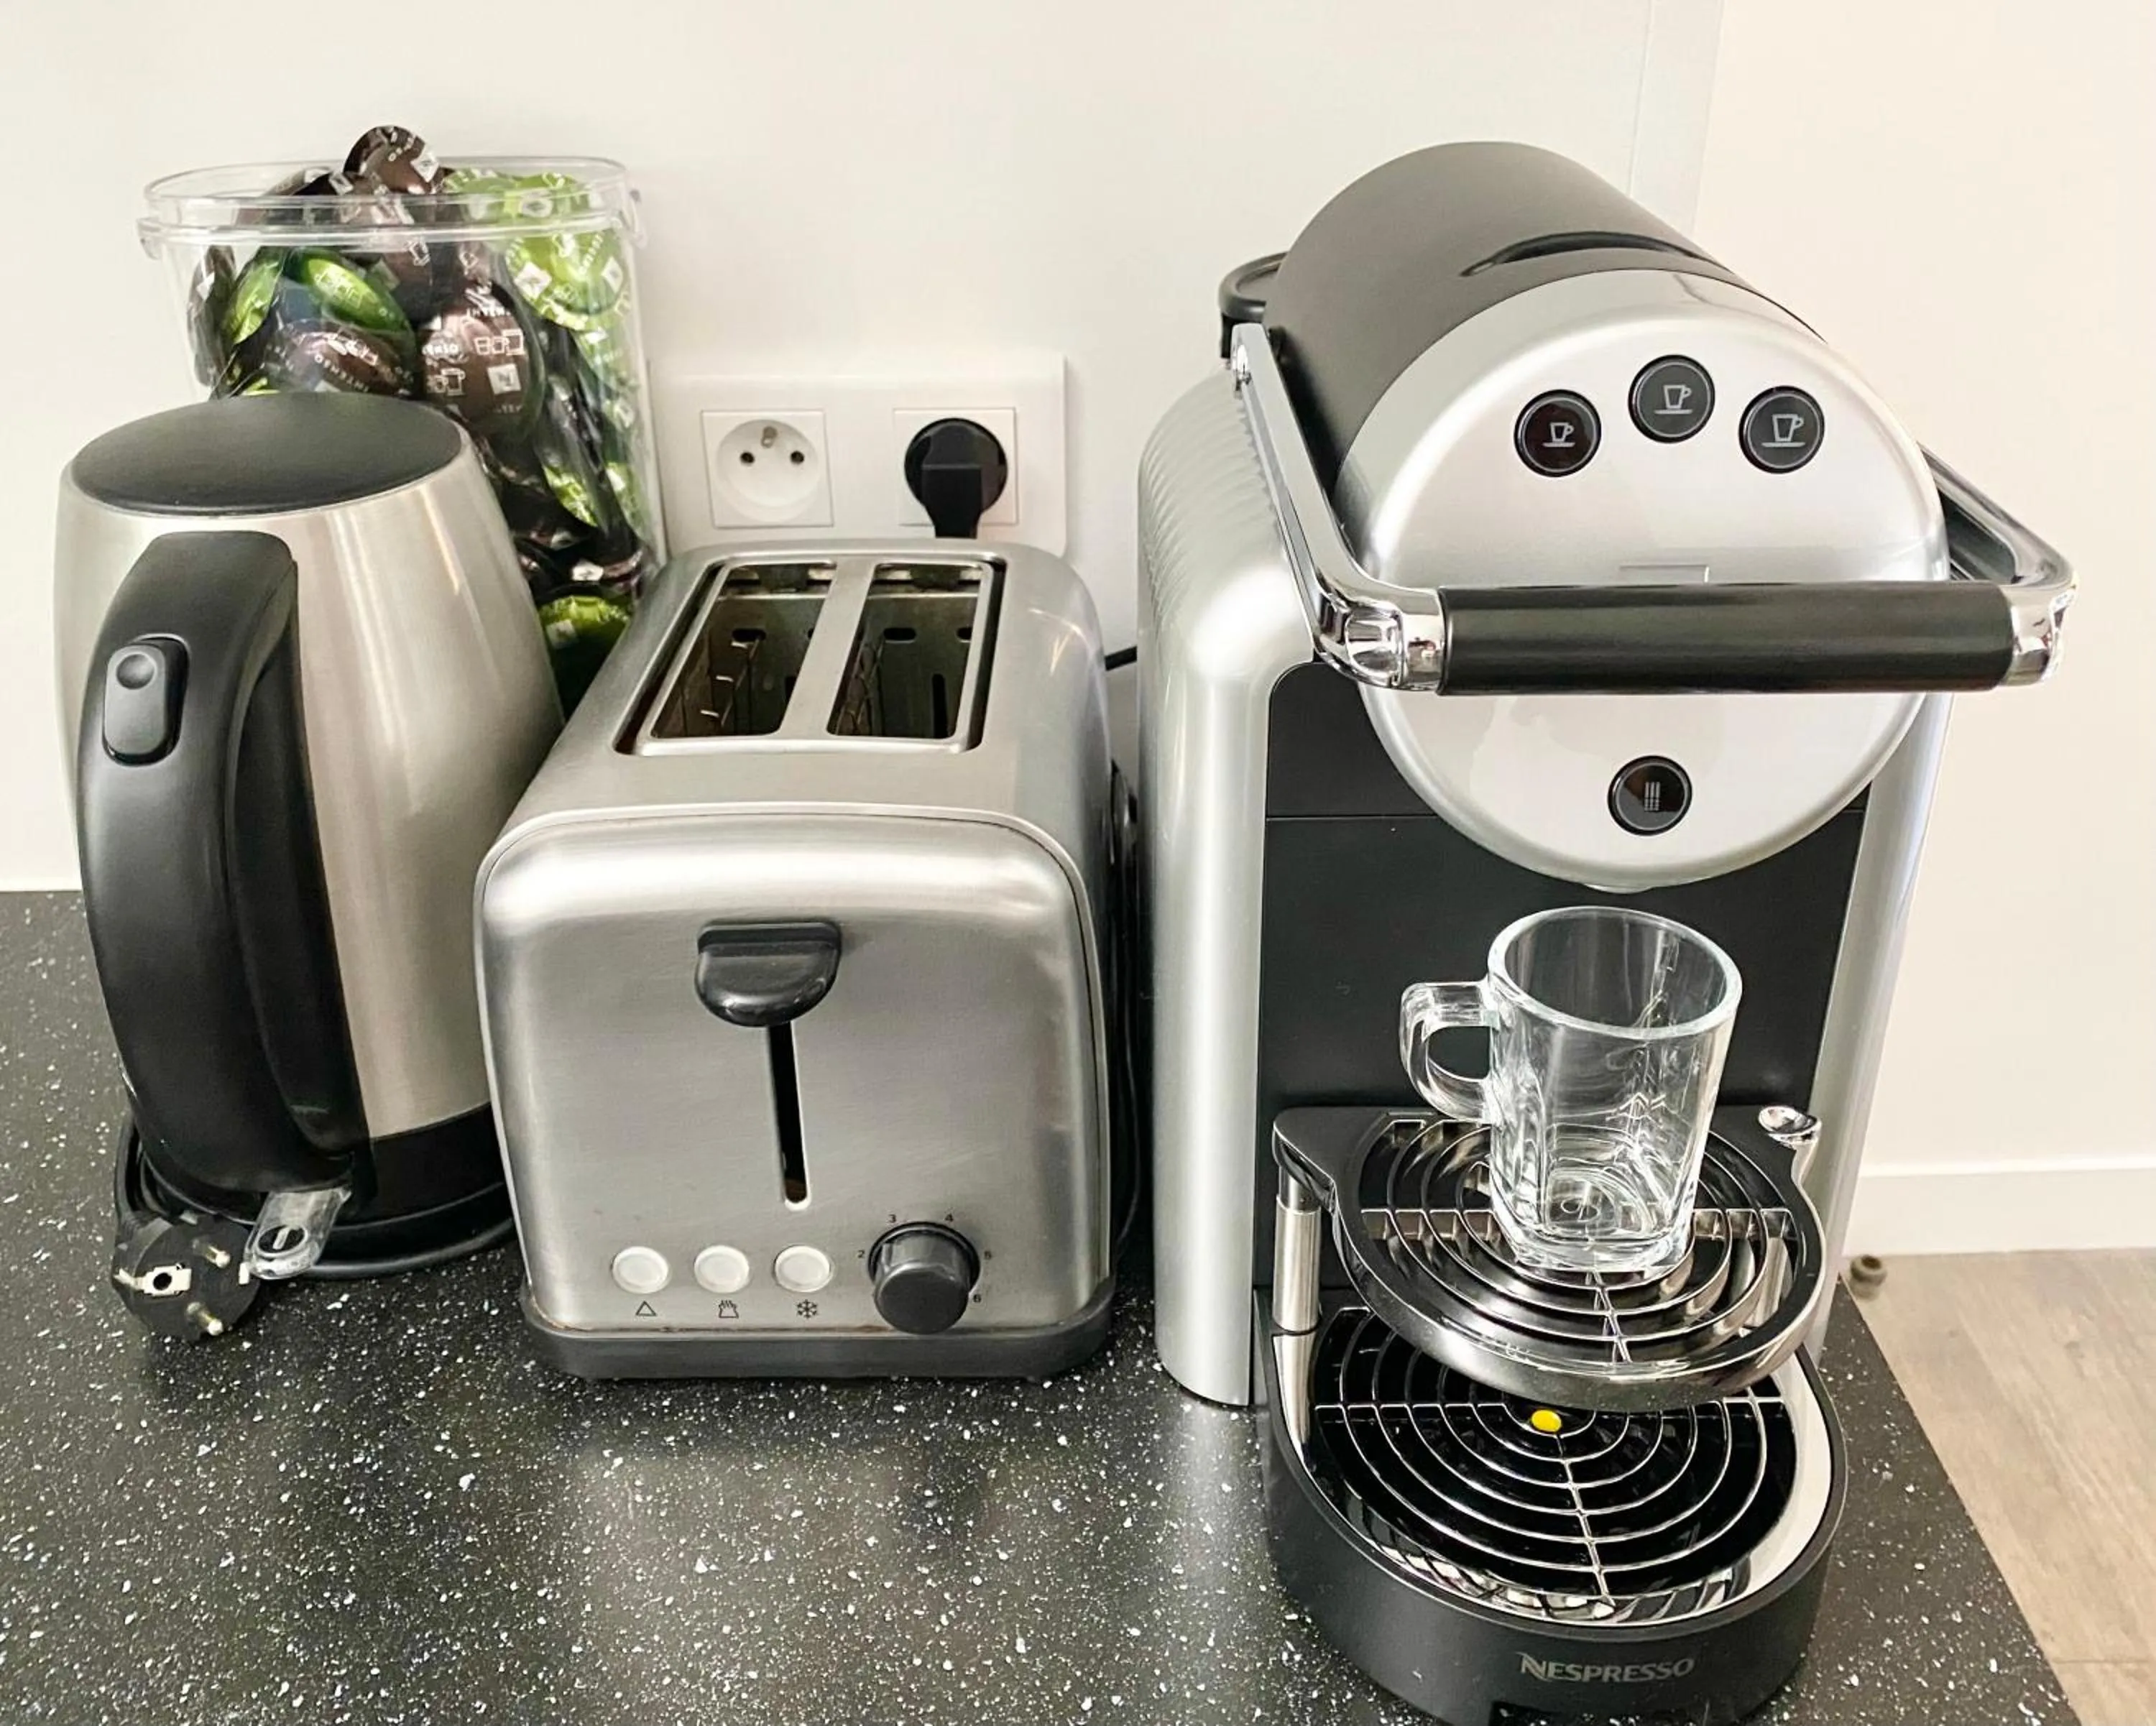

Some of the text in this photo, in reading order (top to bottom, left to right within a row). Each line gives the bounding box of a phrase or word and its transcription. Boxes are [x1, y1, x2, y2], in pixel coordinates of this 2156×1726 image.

[889, 1214, 897, 1222] 3
[945, 1213, 954, 1222] 4
[857, 1250, 865, 1258] 2
[973, 1294, 982, 1303] 6
[1516, 1651, 1695, 1682] NESPRESSO
